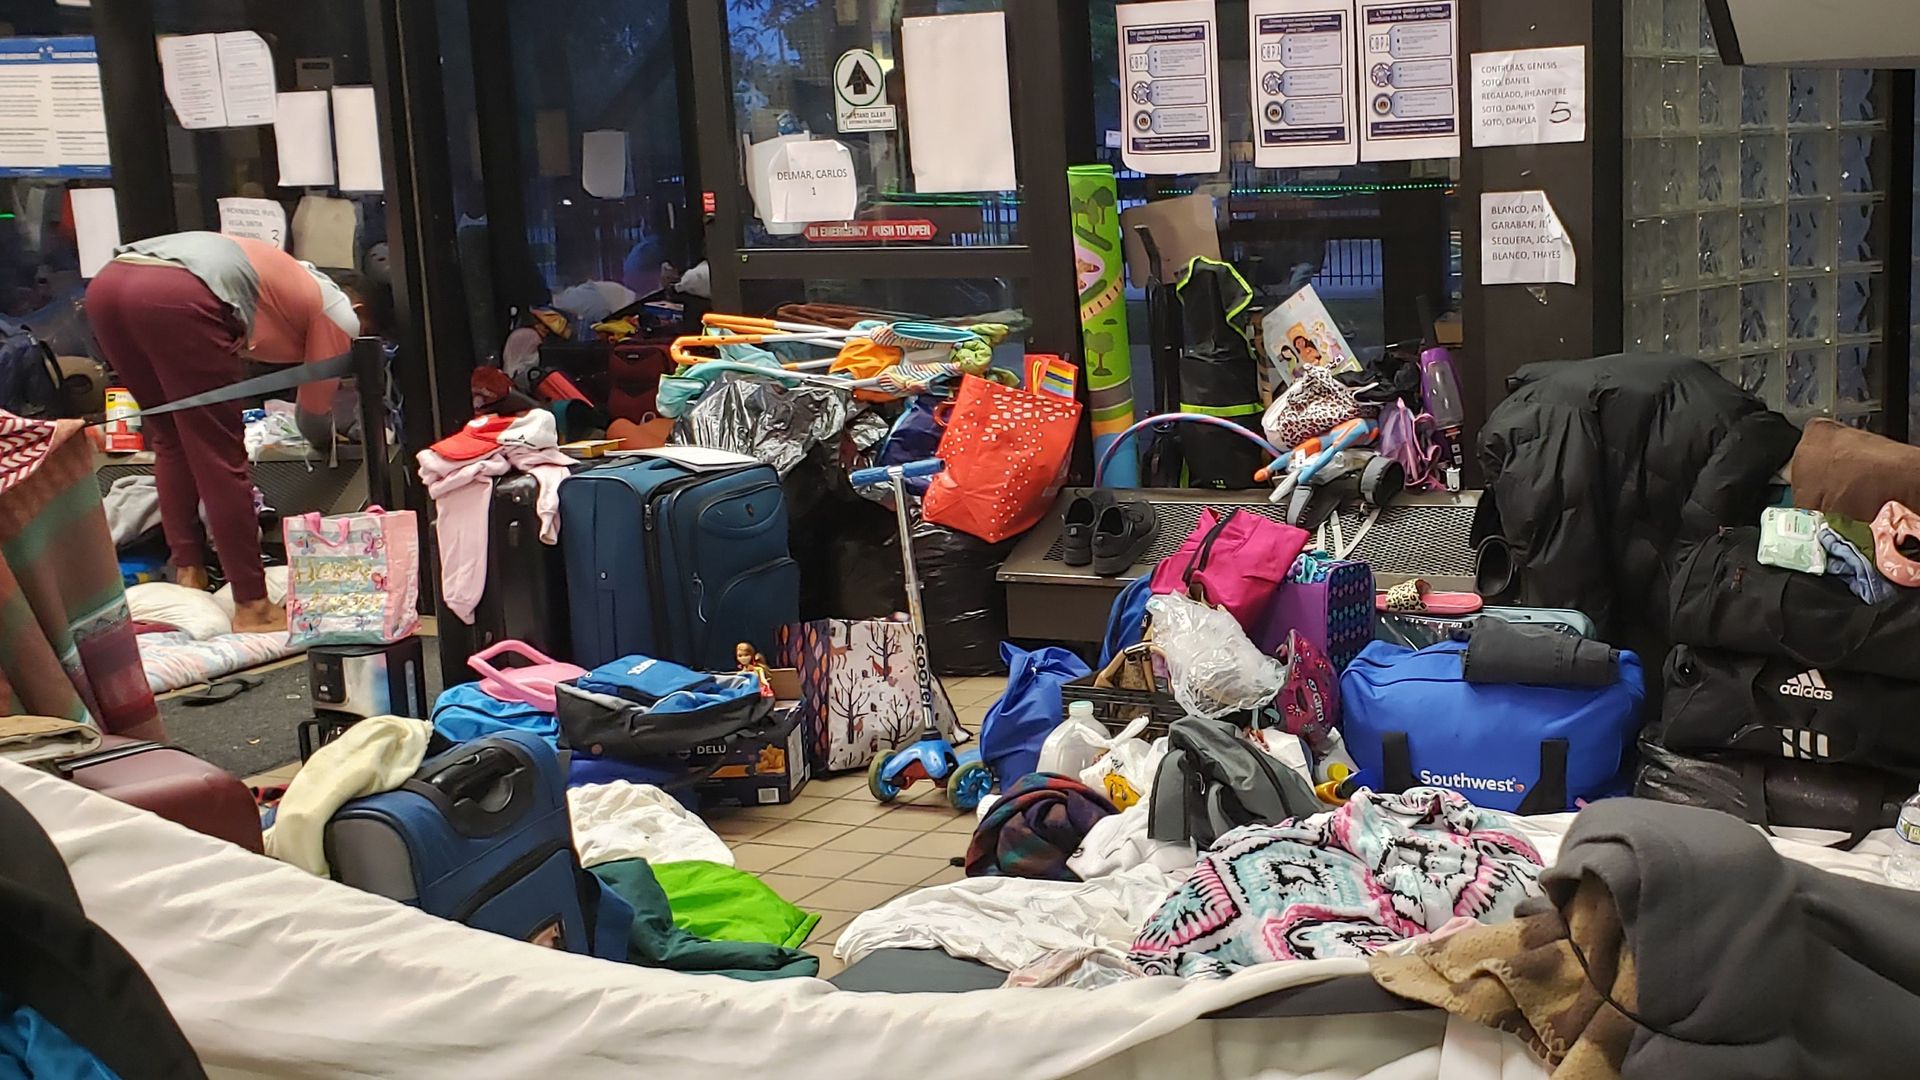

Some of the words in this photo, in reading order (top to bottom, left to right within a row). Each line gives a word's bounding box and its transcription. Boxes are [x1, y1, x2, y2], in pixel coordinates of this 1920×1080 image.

[1481, 64, 1526, 74] CONTRERAS,
[1527, 61, 1558, 70] GENESIS
[1504, 77, 1530, 86] DANIEL
[1481, 91, 1524, 100] REGALADO,
[1482, 105, 1503, 113] SOTO,
[1548, 101, 1572, 124] 5
[1482, 119, 1505, 127] SOTO,
[777, 170, 815, 181] DELMAR,
[816, 168, 848, 179] CARLOS
[811, 187, 817, 196] 1
[1491, 205, 1530, 215] BLANCO,
[1491, 220, 1537, 230] GARABAN,
[820, 225, 868, 237] EMERGENCY
[872, 224, 894, 237] PUSH
[895, 224, 907, 236] TO
[907, 224, 931, 236] OPEN
[1491, 237, 1535, 246] SEQUERA,
[1492, 251, 1530, 261] BLANCO,
[1533, 250, 1561, 259] THAYES
[1779, 684, 1833, 700] adidas
[1420, 769, 1514, 793] Southwest
